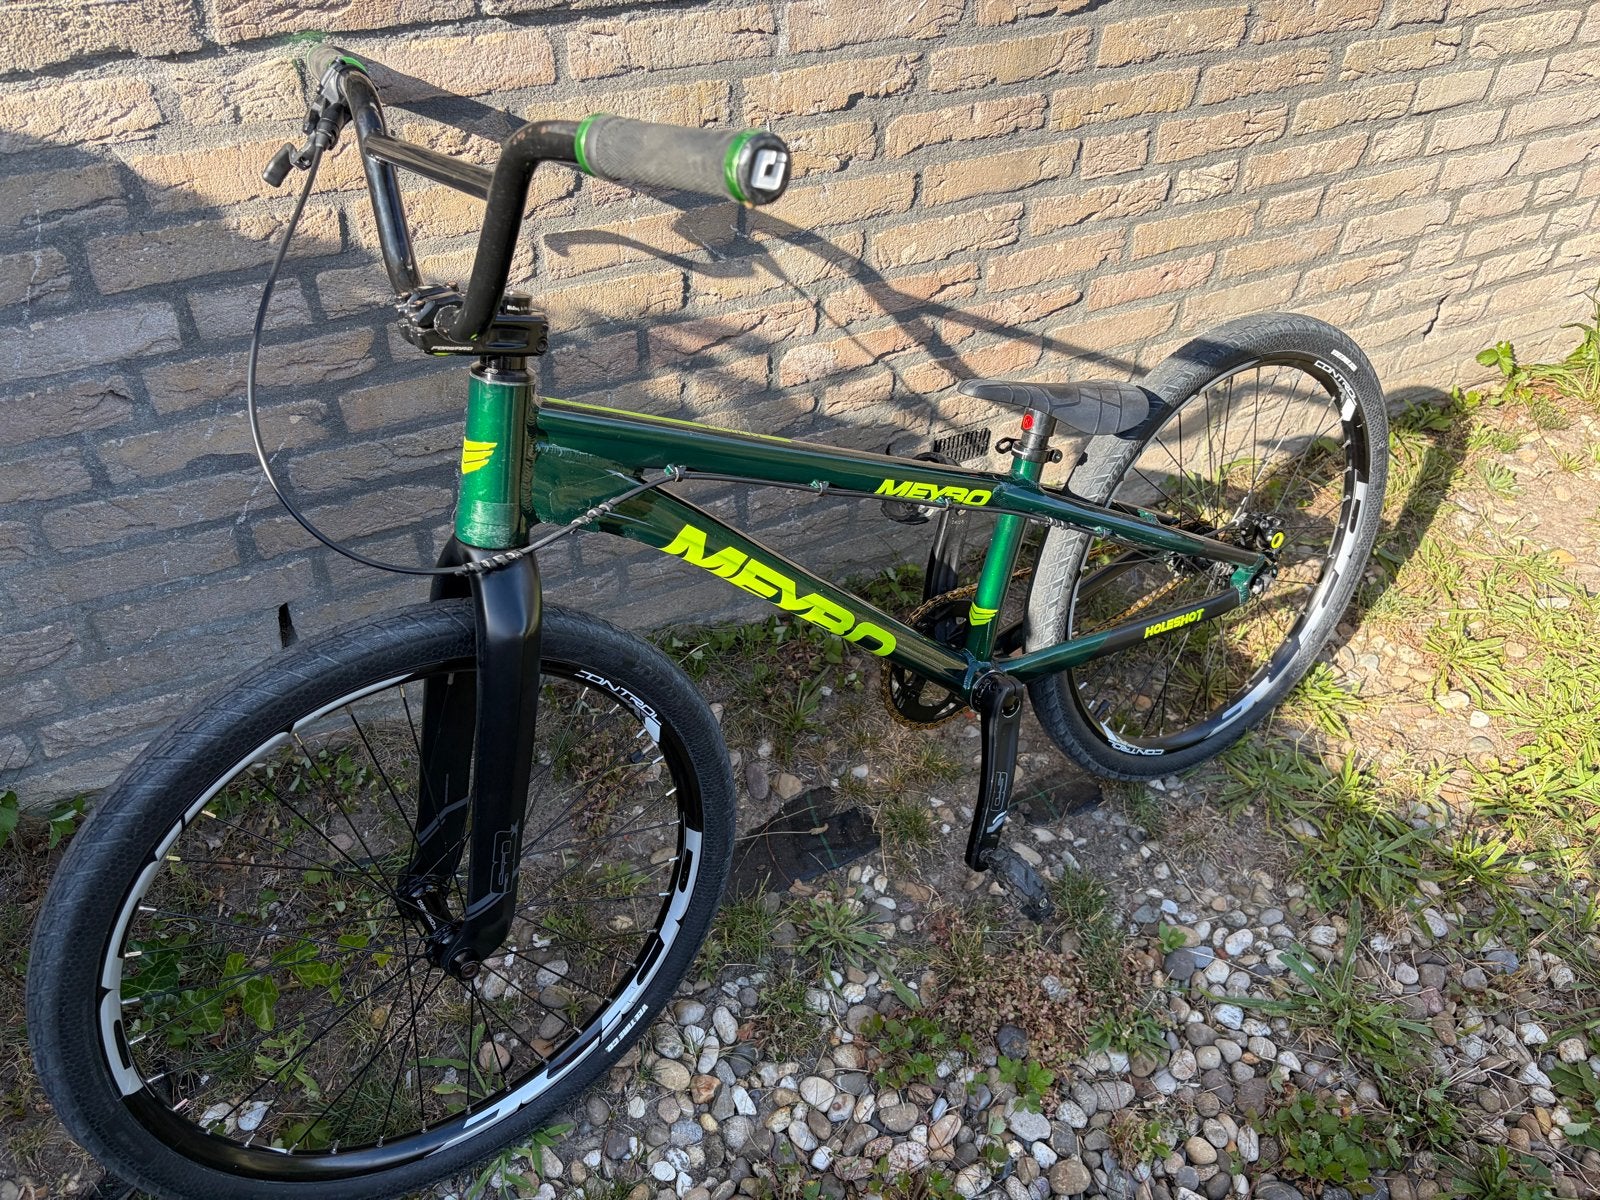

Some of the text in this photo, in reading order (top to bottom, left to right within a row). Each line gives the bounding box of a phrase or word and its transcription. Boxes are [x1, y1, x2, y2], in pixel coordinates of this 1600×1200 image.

[1313, 359, 1358, 406] CONTROL
[874, 478, 992, 506] MEYBO
[659, 523, 897, 657] MEYBO
[1144, 608, 1206, 639] HOLESHOT
[1107, 738, 1165, 757] CONTROL
